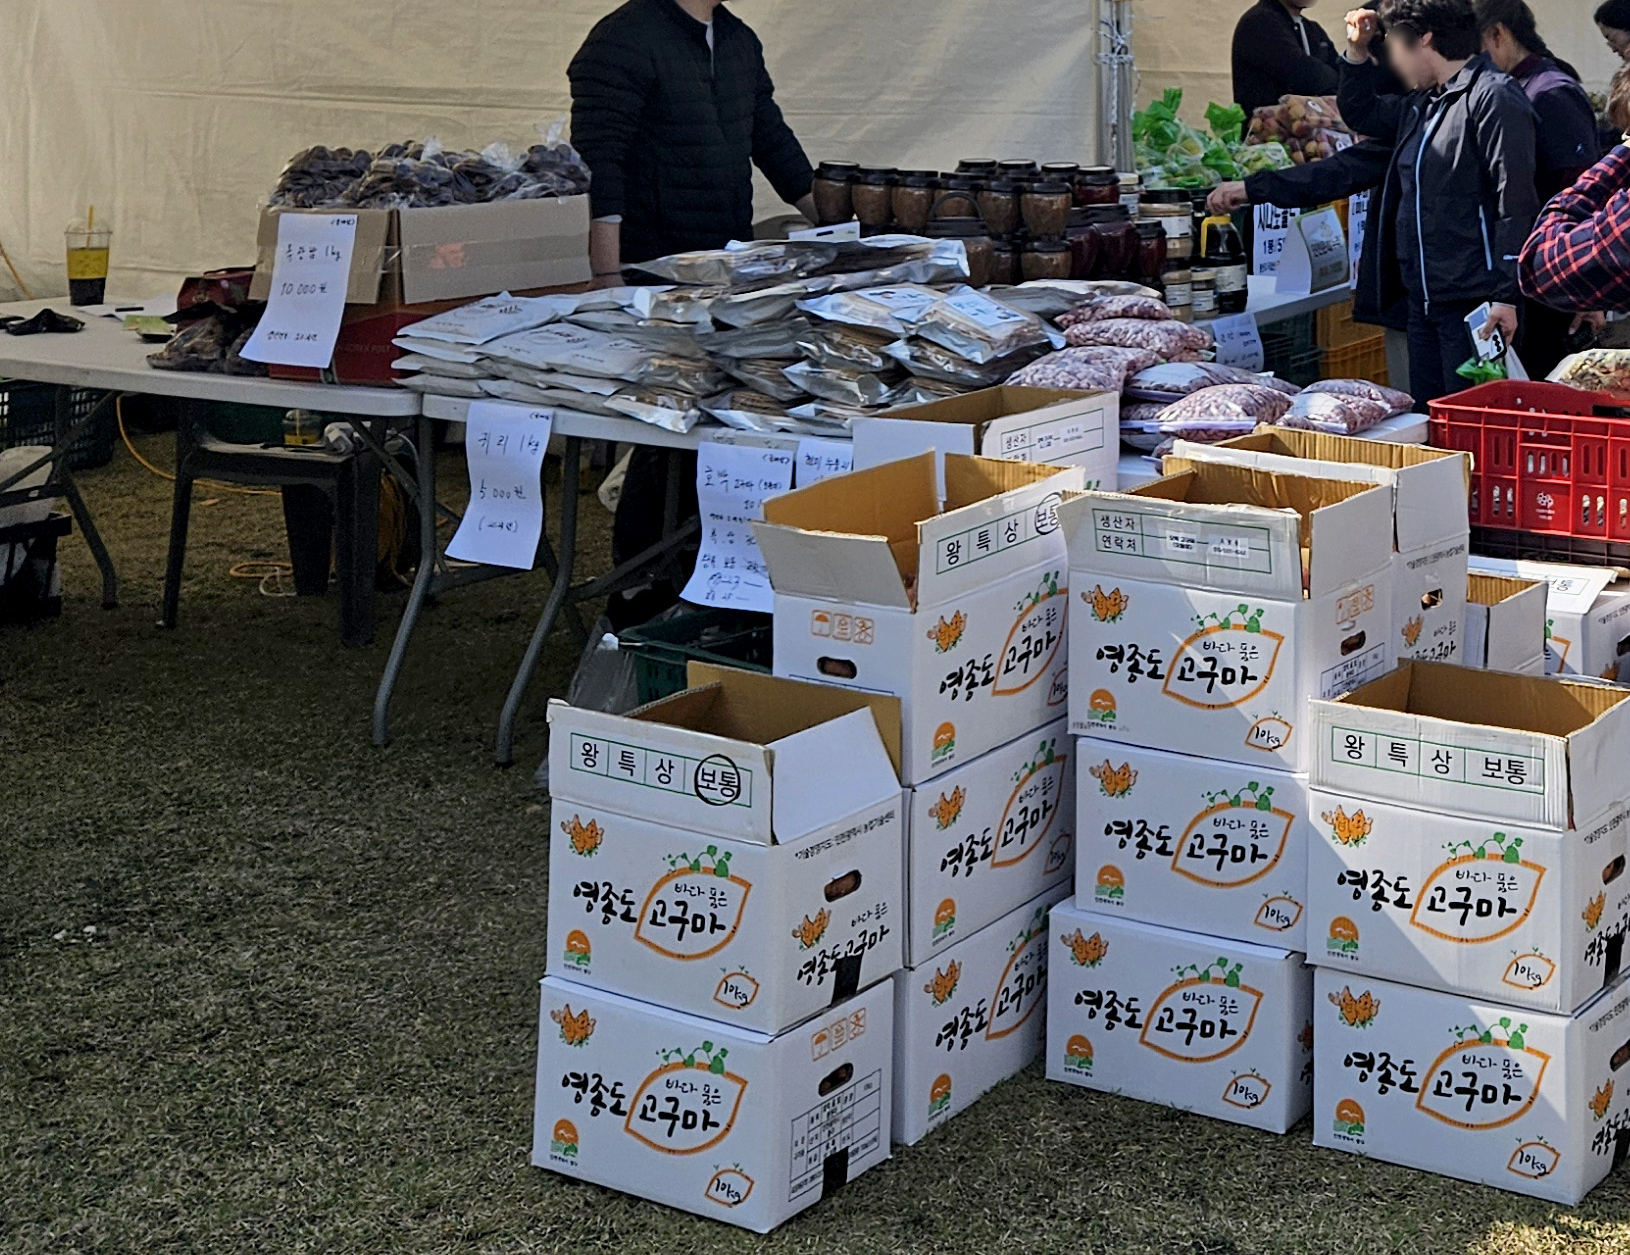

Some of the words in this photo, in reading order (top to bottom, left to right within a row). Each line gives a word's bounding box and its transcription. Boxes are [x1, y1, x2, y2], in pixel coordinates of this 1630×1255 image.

[1100, 514, 1136, 531] 생산자
[946, 540, 961, 566] 왕
[976, 530, 991, 552] 특
[1004, 519, 1019, 543] 상
[1101, 534, 1137, 552] 연락처
[1022, 615, 1043, 633] 바다
[1202, 641, 1235, 653] 바다
[1239, 644, 1260, 662] 품은
[939, 653, 995, 702] 영종도
[1003, 631, 1057, 675] 고구마
[1096, 643, 1165, 683] 영종도
[1177, 656, 1258, 694] 고구마
[1254, 726, 1281, 750] 10kg
[582, 742, 599, 768] 왕
[618, 750, 636, 777] 특
[655, 758, 674, 785] 상
[698, 767, 738, 798] 보통
[1344, 735, 1365, 760] 왕
[1388, 742, 1408, 767] 특
[1431, 750, 1452, 775] 상
[1482, 757, 1527, 785] 보통
[1019, 785, 1039, 804] 바다
[1041, 776, 1055, 797] 품은
[940, 827, 993, 877] 영종도
[1001, 800, 1053, 847] 고구마
[1213, 818, 1245, 830] 바다
[1250, 821, 1270, 839] 품은
[1104, 819, 1174, 859] 영종도
[1187, 833, 1268, 872] 고구마
[1455, 870, 1492, 883] 바다
[1496, 873, 1518, 893] 품은
[674, 883, 706, 897] 바다
[708, 887, 727, 908] 품은
[1337, 869, 1413, 911] 영종도
[1427, 887, 1517, 926] 고구마
[573, 881, 637, 924] 영종도
[649, 899, 726, 941] 고구마
[851, 910, 873, 927] 바다
[1264, 905, 1291, 928] 10kg
[845, 924, 890, 959] 고구마
[1514, 962, 1542, 986] 10kg
[724, 981, 748, 1006] 10kg
[1182, 992, 1215, 1005] 바다
[1219, 996, 1239, 1015] 품은
[935, 998, 988, 1052] 영종도
[996, 965, 1048, 1017] 고구마
[1074, 989, 1142, 1031] 영종도
[1155, 1007, 1237, 1046] 고구마
[1462, 1055, 1497, 1068] 바다
[1501, 1059, 1523, 1079] 품은
[666, 1078, 698, 1093] 바다
[702, 1085, 722, 1106] 품은
[1233, 1082, 1259, 1107] 10kg
[1344, 1052, 1419, 1095] 영종도
[1432, 1070, 1522, 1112] 고구마
[562, 1072, 627, 1117] 영종도
[639, 1095, 720, 1137] 고구마
[1519, 1149, 1549, 1176] 10kg
[716, 1178, 741, 1205] 10kg
